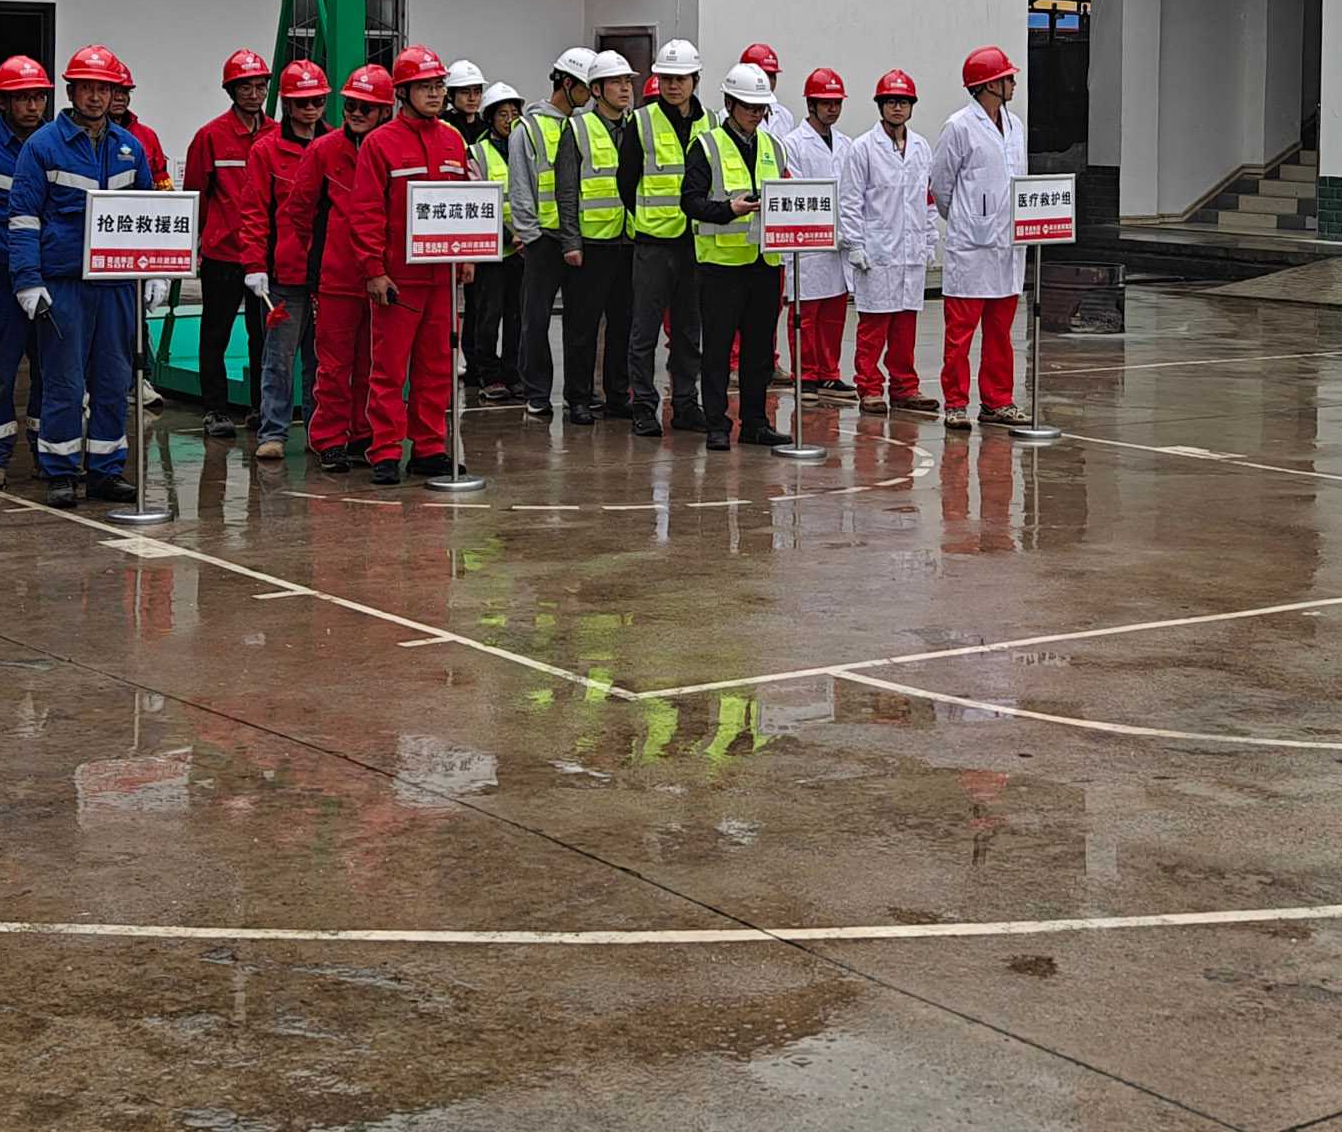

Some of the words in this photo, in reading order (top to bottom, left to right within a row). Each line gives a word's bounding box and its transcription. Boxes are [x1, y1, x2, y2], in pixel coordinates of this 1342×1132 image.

[768, 196, 831, 212] 后勤保障组
[1018, 190, 1071, 208] 医疗救护组
[416, 202, 495, 220] 警戒疏散组
[98, 214, 190, 234] 抢险救援组
